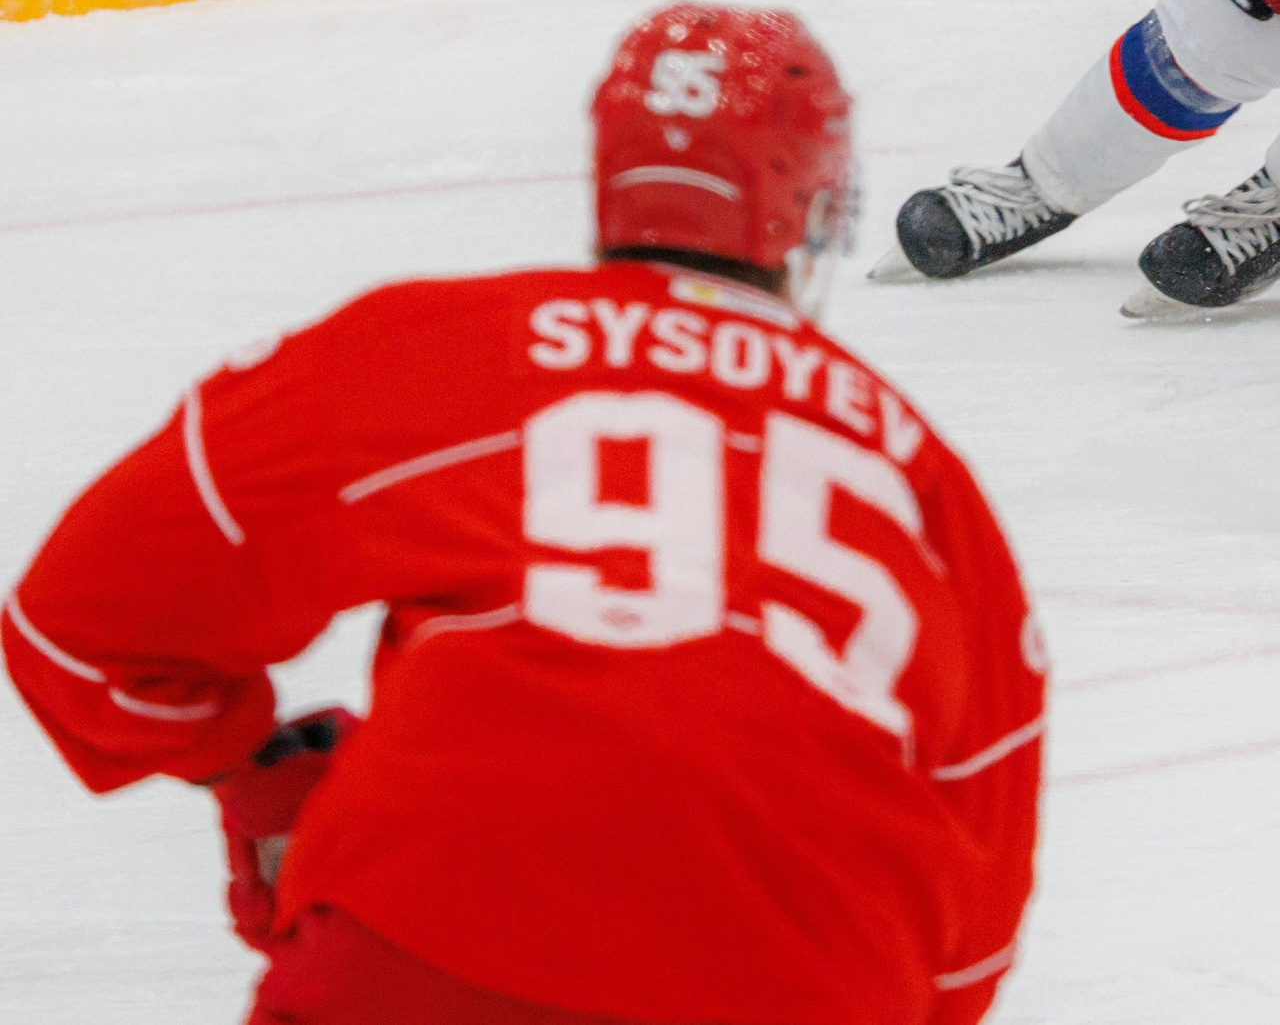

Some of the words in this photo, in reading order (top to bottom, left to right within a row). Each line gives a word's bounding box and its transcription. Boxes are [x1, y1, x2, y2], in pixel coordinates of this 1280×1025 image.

[643, 50, 727, 118] 95
[528, 297, 923, 464] SYSOYEV
[522, 390, 922, 735] 95
